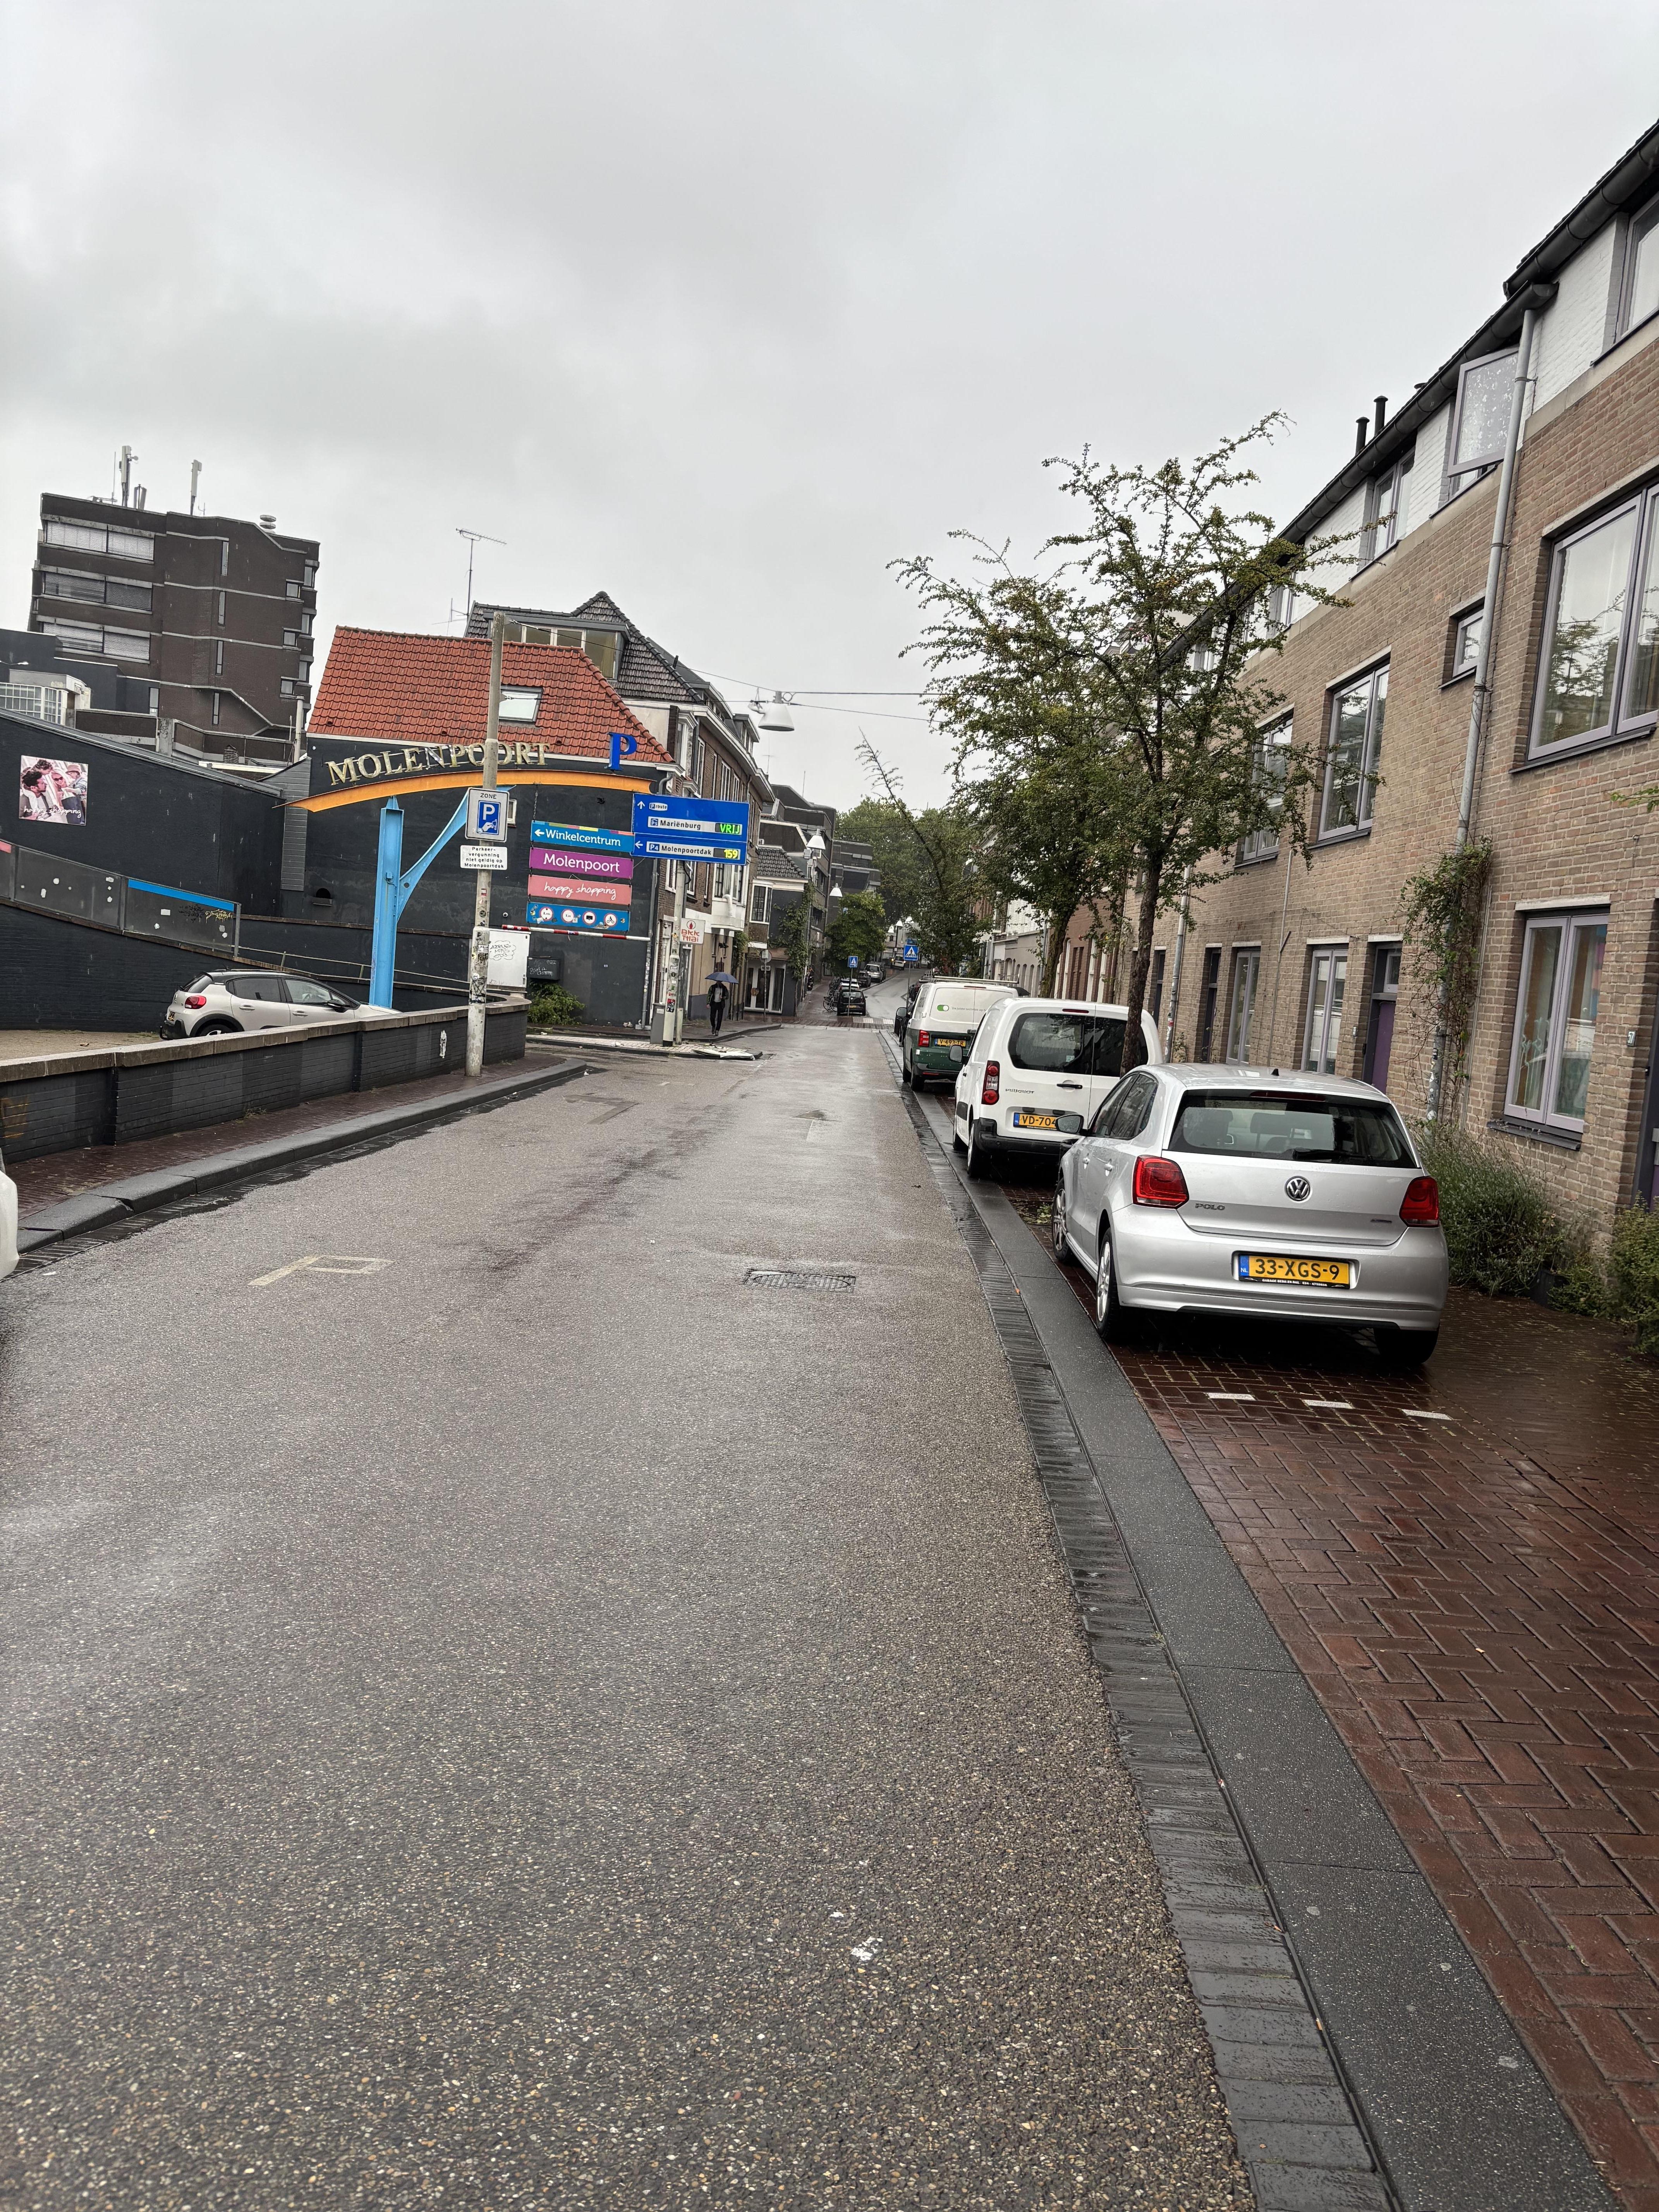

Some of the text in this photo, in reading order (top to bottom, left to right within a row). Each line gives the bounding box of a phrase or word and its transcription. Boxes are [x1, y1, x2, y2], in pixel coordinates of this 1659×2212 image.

[608, 732, 637, 771] P
[325, 742, 550, 786] MOLENPOORT
[24, 806, 81, 818] happy shopping
[483, 804, 495, 820] P
[660, 820, 701, 830] Mariënburg
[720, 824, 740, 833] VRIJ
[545, 829, 621, 846] Winkelcentrum
[661, 845, 711, 855] Molenpoortdak
[724, 849, 738, 859] 159
[543, 853, 620, 872] Molenpoort
[544, 882, 617, 900] happy shopping
[1628, 1031, 1635, 1044] 57
[1255, 1259, 1340, 1280] 33-XGS-9
